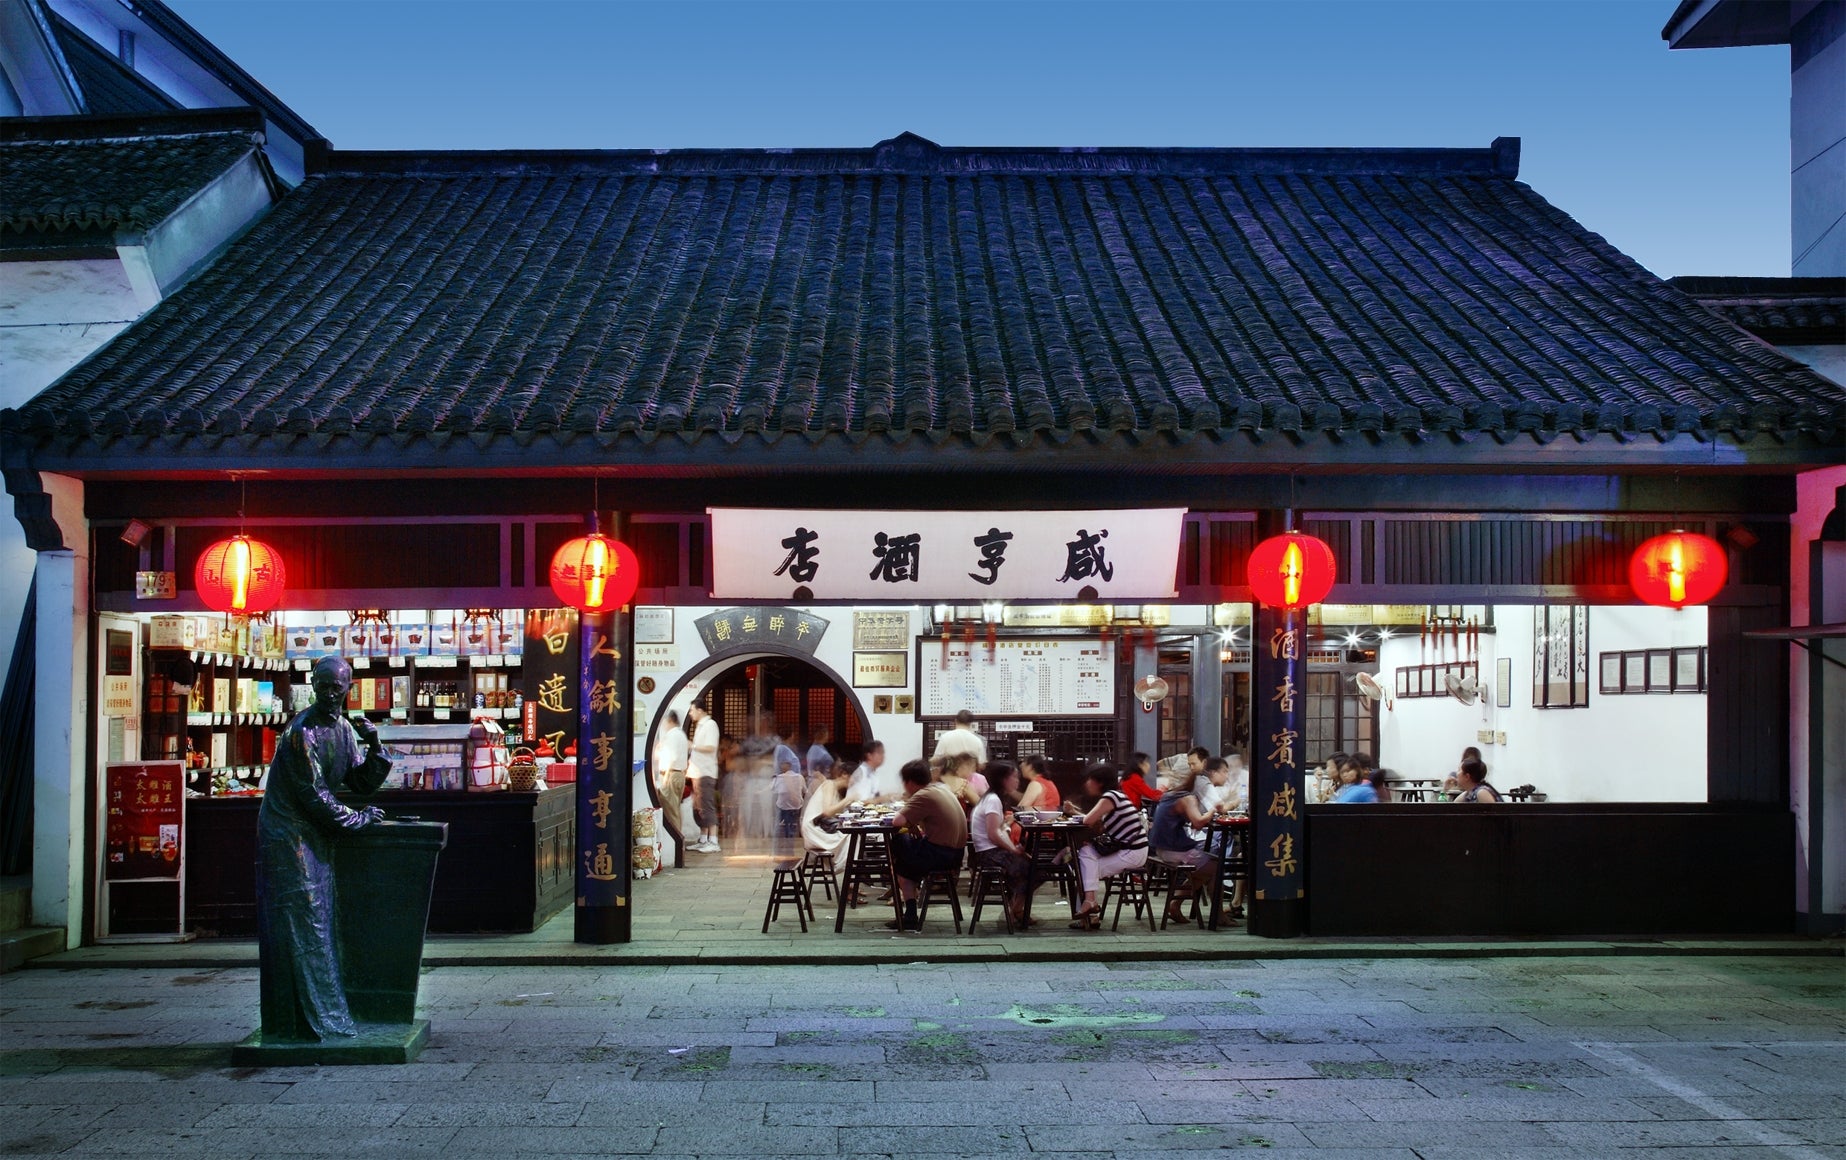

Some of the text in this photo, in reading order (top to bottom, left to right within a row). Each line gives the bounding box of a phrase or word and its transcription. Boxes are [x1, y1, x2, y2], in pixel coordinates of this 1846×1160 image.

[773, 527, 1113, 585] 咸亨酒店
[147, 575, 166, 587] 179
